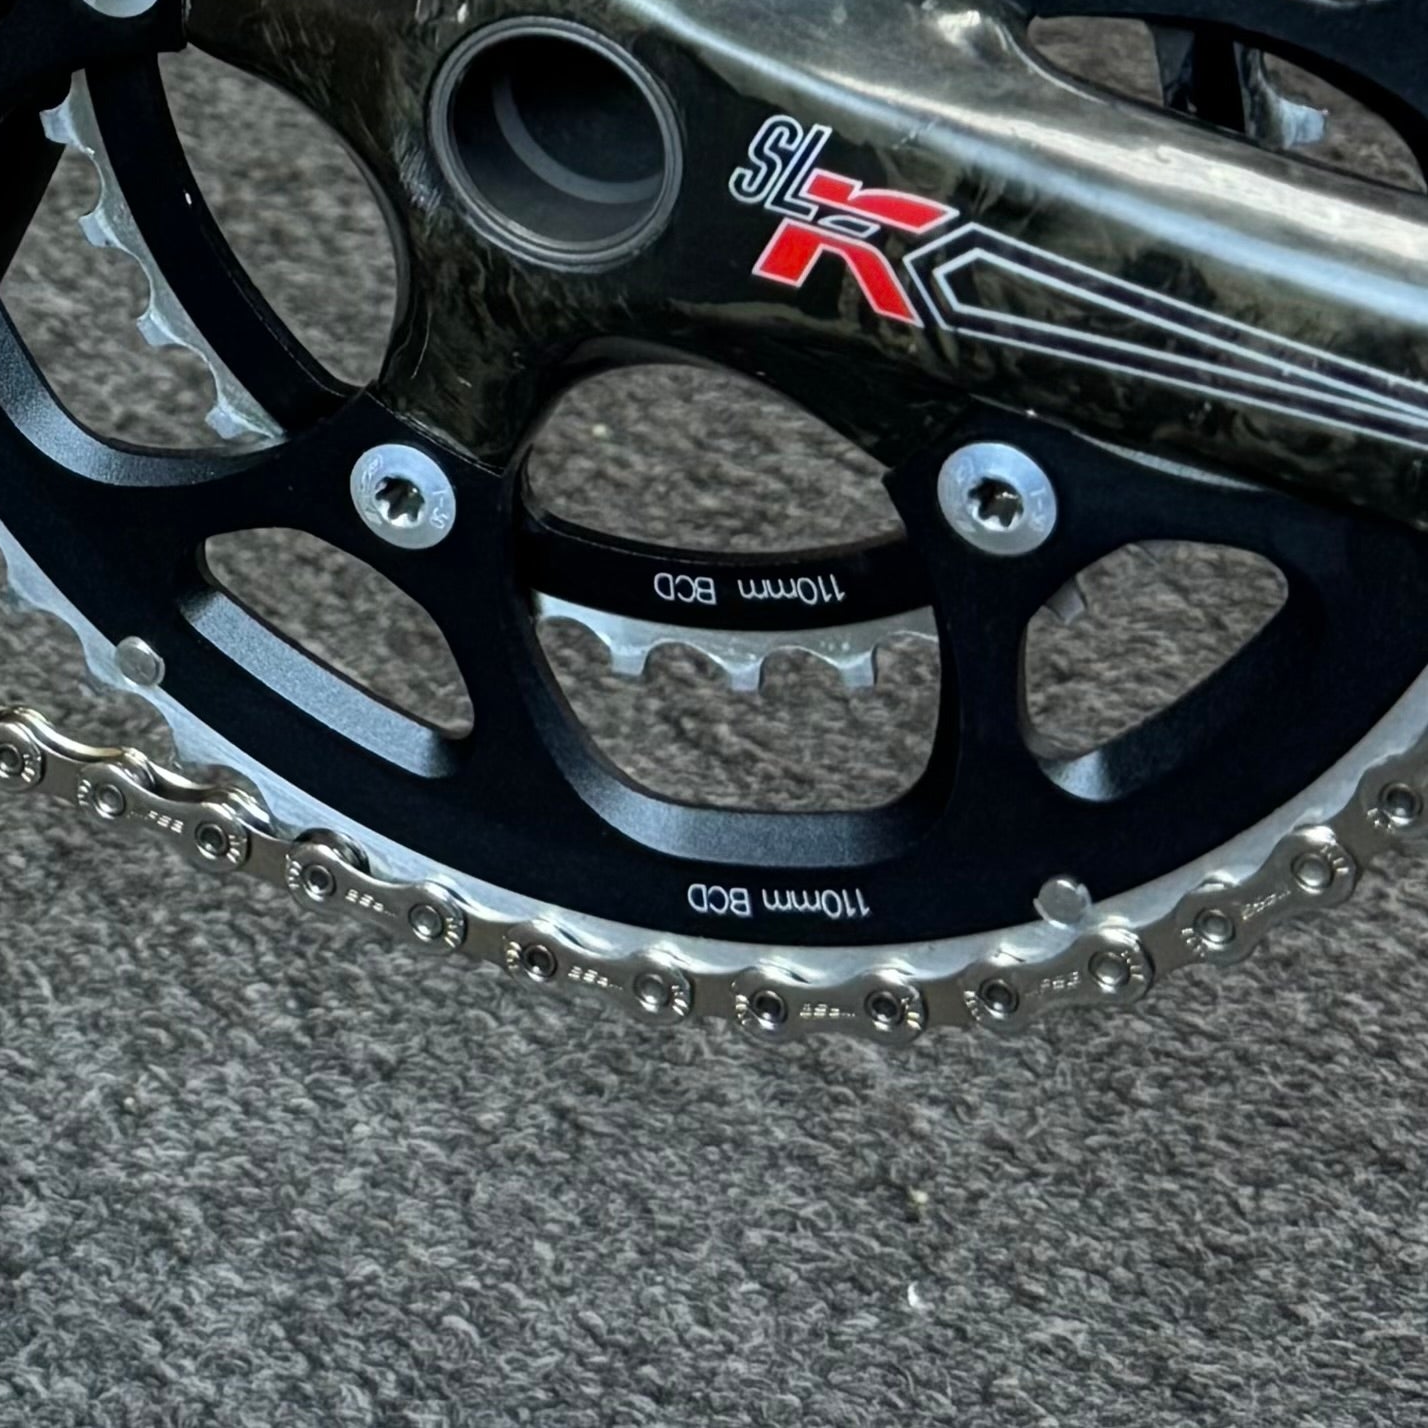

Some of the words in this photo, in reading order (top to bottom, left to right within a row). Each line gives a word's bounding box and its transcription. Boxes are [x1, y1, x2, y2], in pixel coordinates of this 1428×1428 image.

[653, 571, 718, 605] BCD
[738, 572, 846, 603] 110mm
[687, 882, 752, 917] BCD
[762, 887, 871, 917] 110mm
